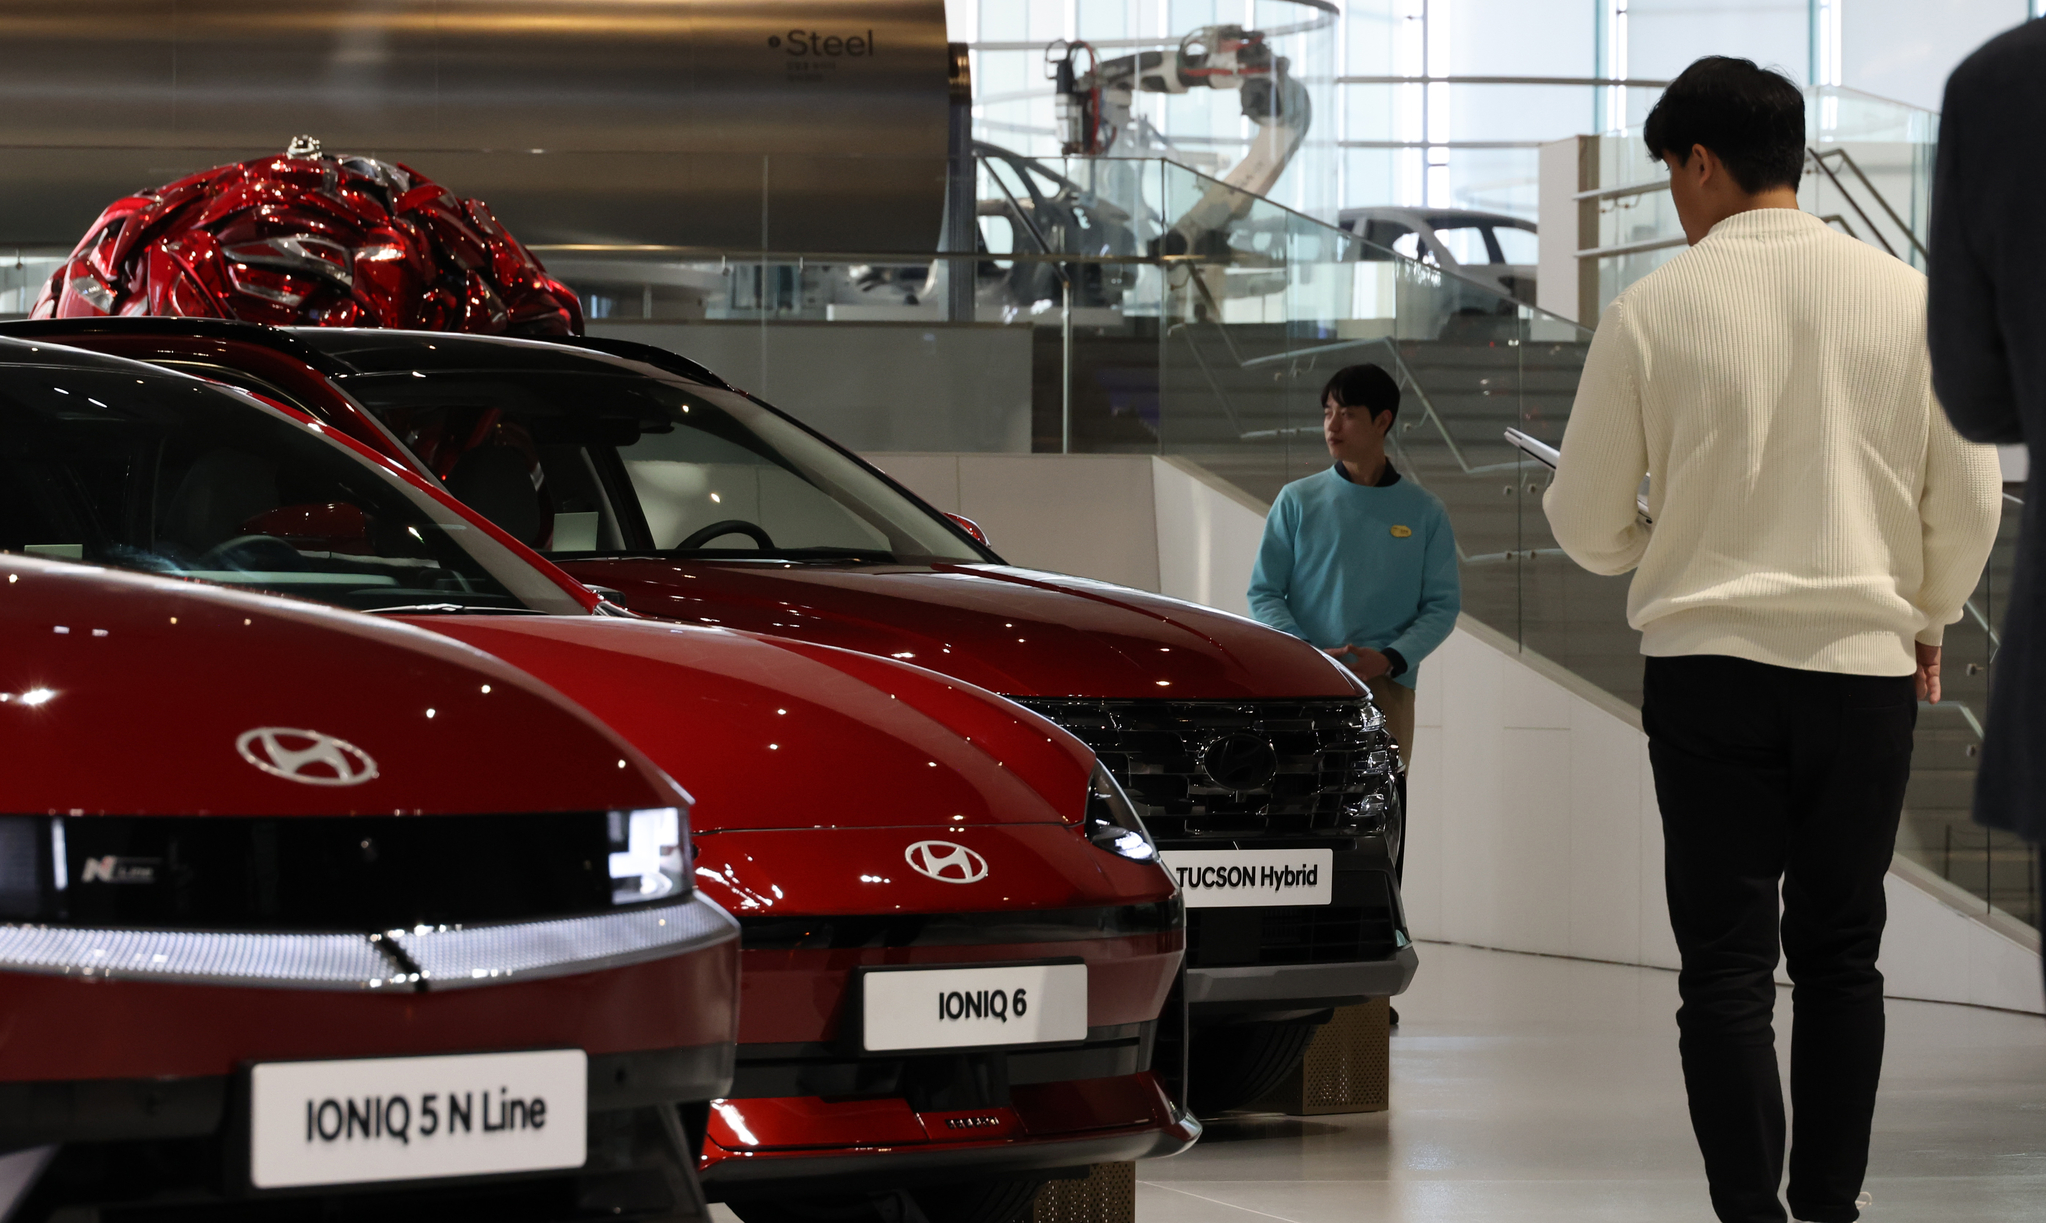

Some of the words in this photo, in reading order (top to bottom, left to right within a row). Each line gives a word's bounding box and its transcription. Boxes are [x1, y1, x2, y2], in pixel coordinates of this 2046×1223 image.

[786, 29, 873, 57] Steel
[82, 855, 117, 882] N
[1176, 866, 1256, 888] TUCSON
[1261, 864, 1318, 891] Hybrid
[939, 989, 1007, 1023] IONIQ
[1013, 988, 1027, 1017] 6
[307, 1096, 410, 1145] IONIQ
[420, 1093, 438, 1136] 5
[449, 1092, 472, 1134] N
[483, 1086, 546, 1132] Line
